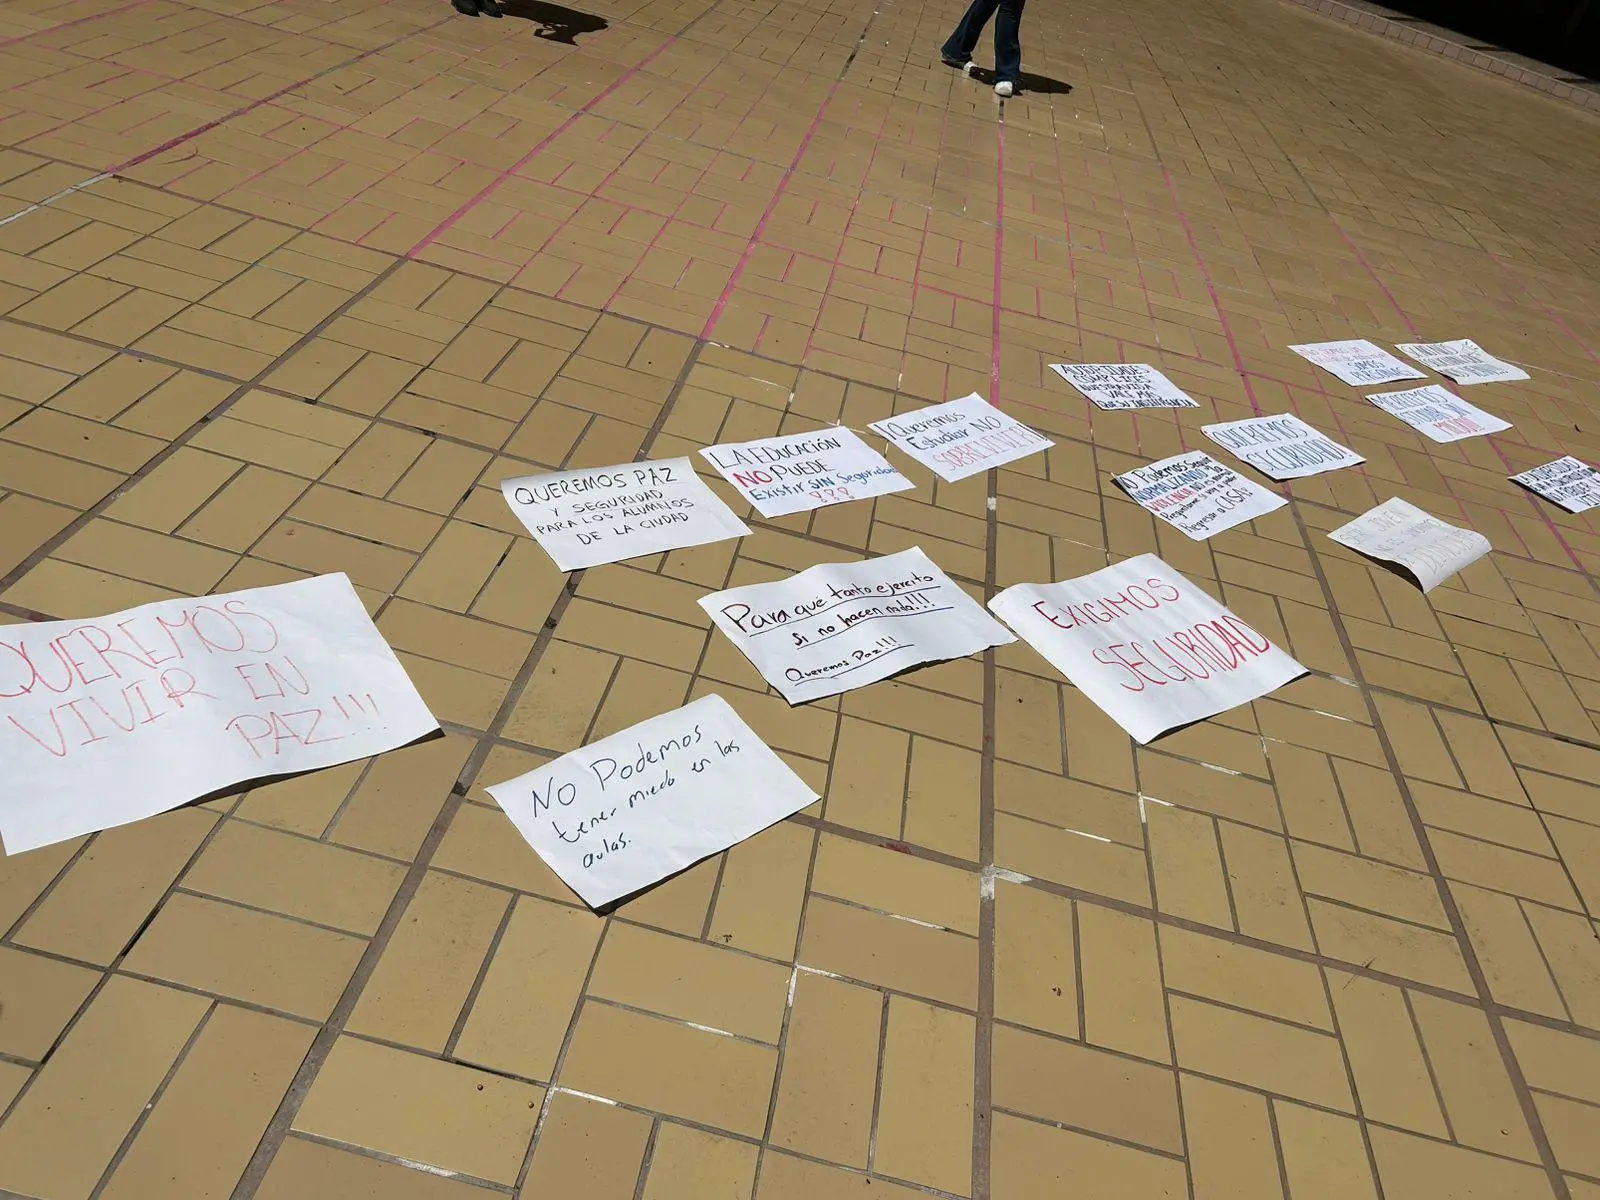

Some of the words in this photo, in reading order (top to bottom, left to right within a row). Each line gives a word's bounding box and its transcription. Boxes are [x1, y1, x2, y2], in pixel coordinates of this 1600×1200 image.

[1060, 364, 1150, 376] AUTORIDADES
[1349, 367, 1415, 380] PERSONAS
[1367, 386, 1448, 411] MERECEMOS
[906, 428, 969, 451] Estudiar
[969, 415, 1002, 433] NO
[1212, 419, 1307, 448] QUEREMOS
[710, 449, 753, 469] LA
[1132, 460, 1188, 483] Podemos
[515, 473, 628, 505] QUEREMOS
[635, 467, 678, 487] PAZ
[733, 470, 773, 488] NO
[807, 477, 835, 490] SIN
[1131, 469, 1209, 502] NORMALIZANDO
[573, 489, 663, 513] SEGURIDAD
[1144, 487, 1197, 512] VIOLENCIA
[1189, 480, 1205, 491] NO
[536, 520, 578, 534] PARA
[584, 513, 613, 524] LOS
[576, 531, 602, 545] DE
[614, 524, 635, 535] LA
[640, 512, 689, 529] CIUDAD
[1179, 512, 1217, 533] Regresar
[720, 603, 792, 633] Para
[827, 583, 872, 600] tanto
[1031, 577, 1179, 630] EXIGIMOS
[817, 624, 836, 637] no
[842, 607, 882, 627] hacen
[1091, 615, 1270, 692] SEGURIDAD
[785, 660, 850, 682] Queremos
[7, 668, 219, 757] VIVIR
[235, 655, 310, 700] EN
[532, 777, 576, 818] NO
[589, 724, 702, 791] Podemos
[551, 807, 617, 843] tener
[629, 769, 675, 808] miedo
[714, 740, 740, 758] las
